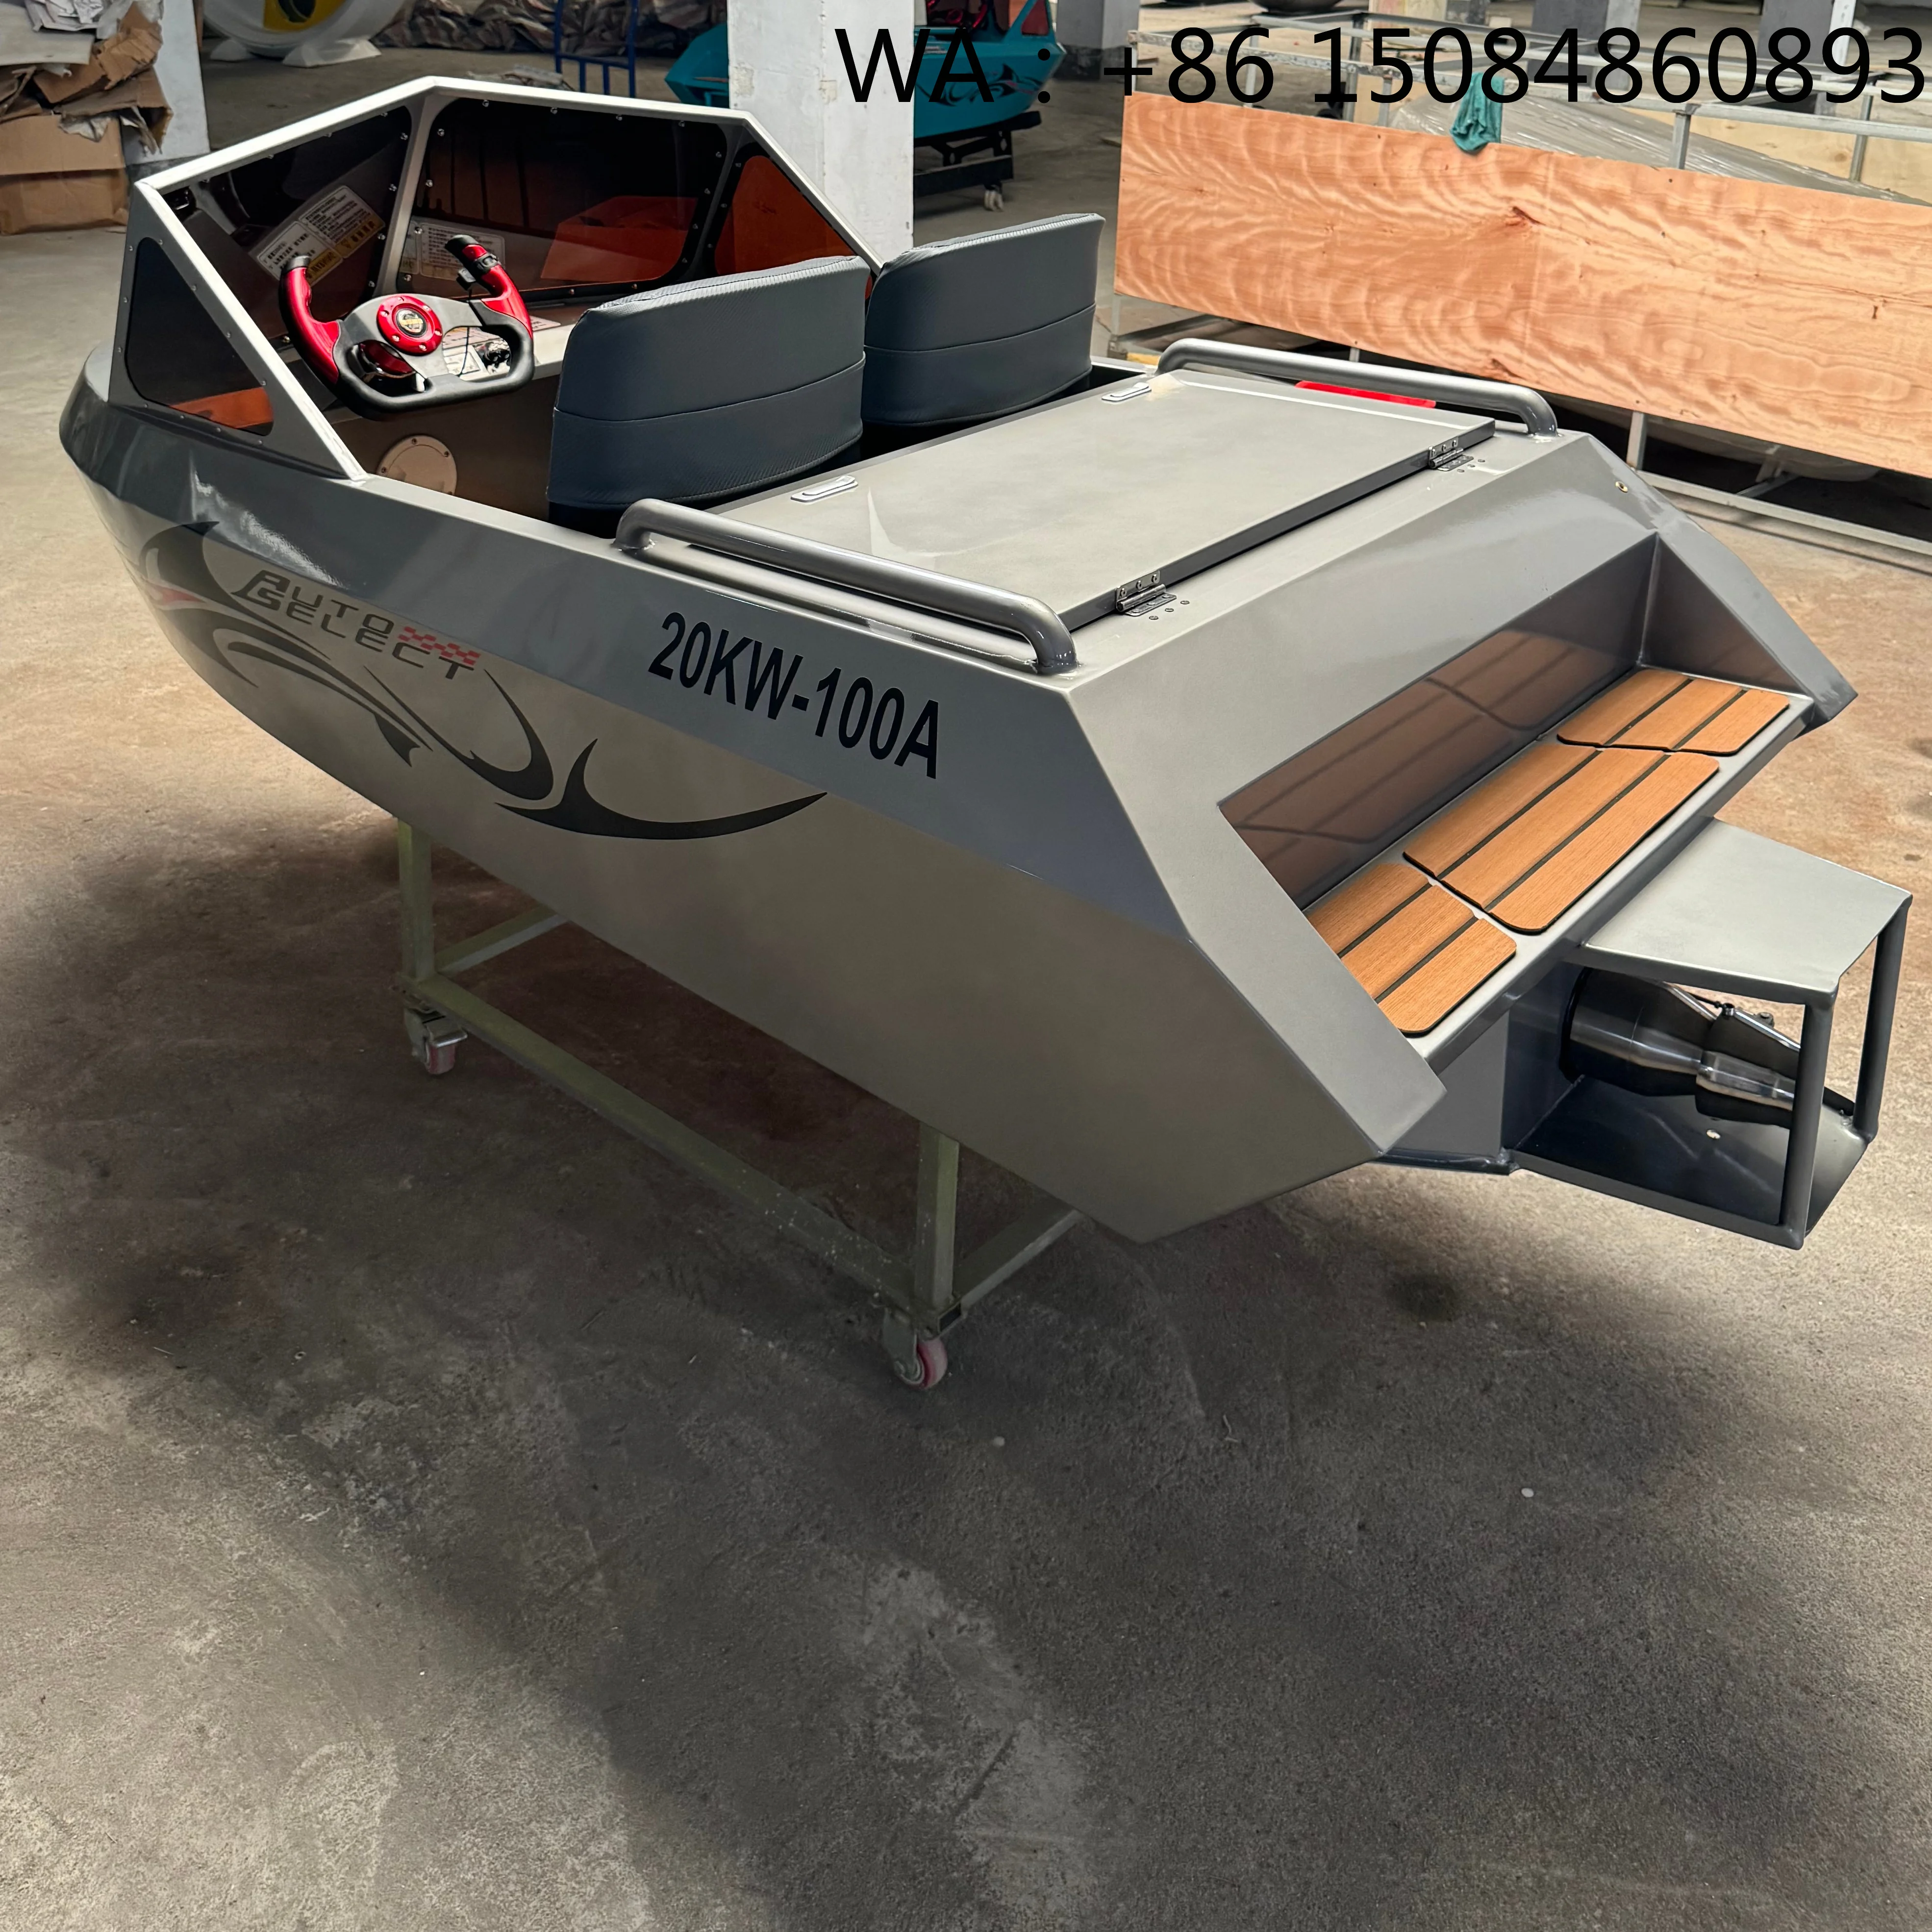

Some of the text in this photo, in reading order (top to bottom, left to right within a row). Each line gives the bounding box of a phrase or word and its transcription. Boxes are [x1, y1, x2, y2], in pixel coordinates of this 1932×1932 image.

[231, 570, 395, 634] AUTO
[236, 587, 475, 680] SELECT
[648, 611, 939, 779] 20KW-100A
